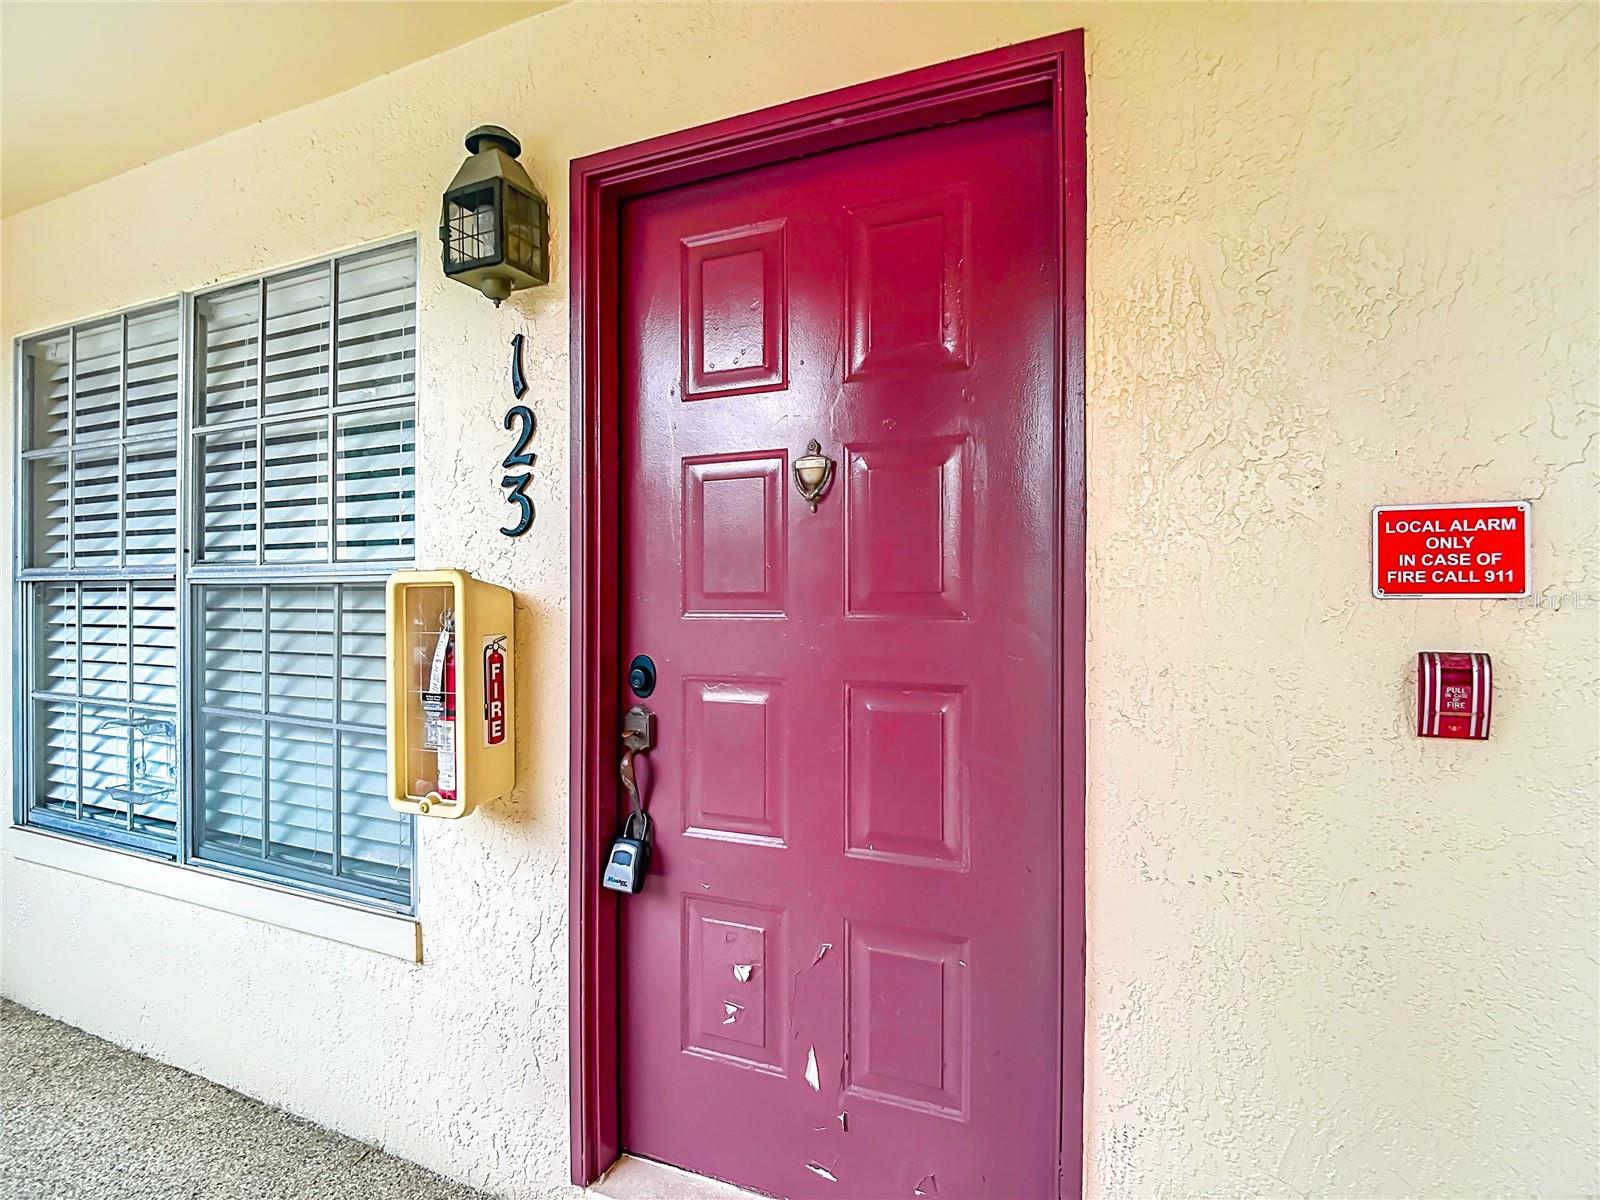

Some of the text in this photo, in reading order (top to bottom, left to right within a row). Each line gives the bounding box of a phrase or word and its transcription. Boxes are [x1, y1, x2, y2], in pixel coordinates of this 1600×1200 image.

[1385, 518, 1516, 533] LOCAL ALARM
[1426, 536, 1474, 549] ONLY
[1399, 552, 1502, 566] IN CASE OF
[1387, 570, 1514, 583] FIRE CALL 911
[491, 663, 502, 737] FIRE
